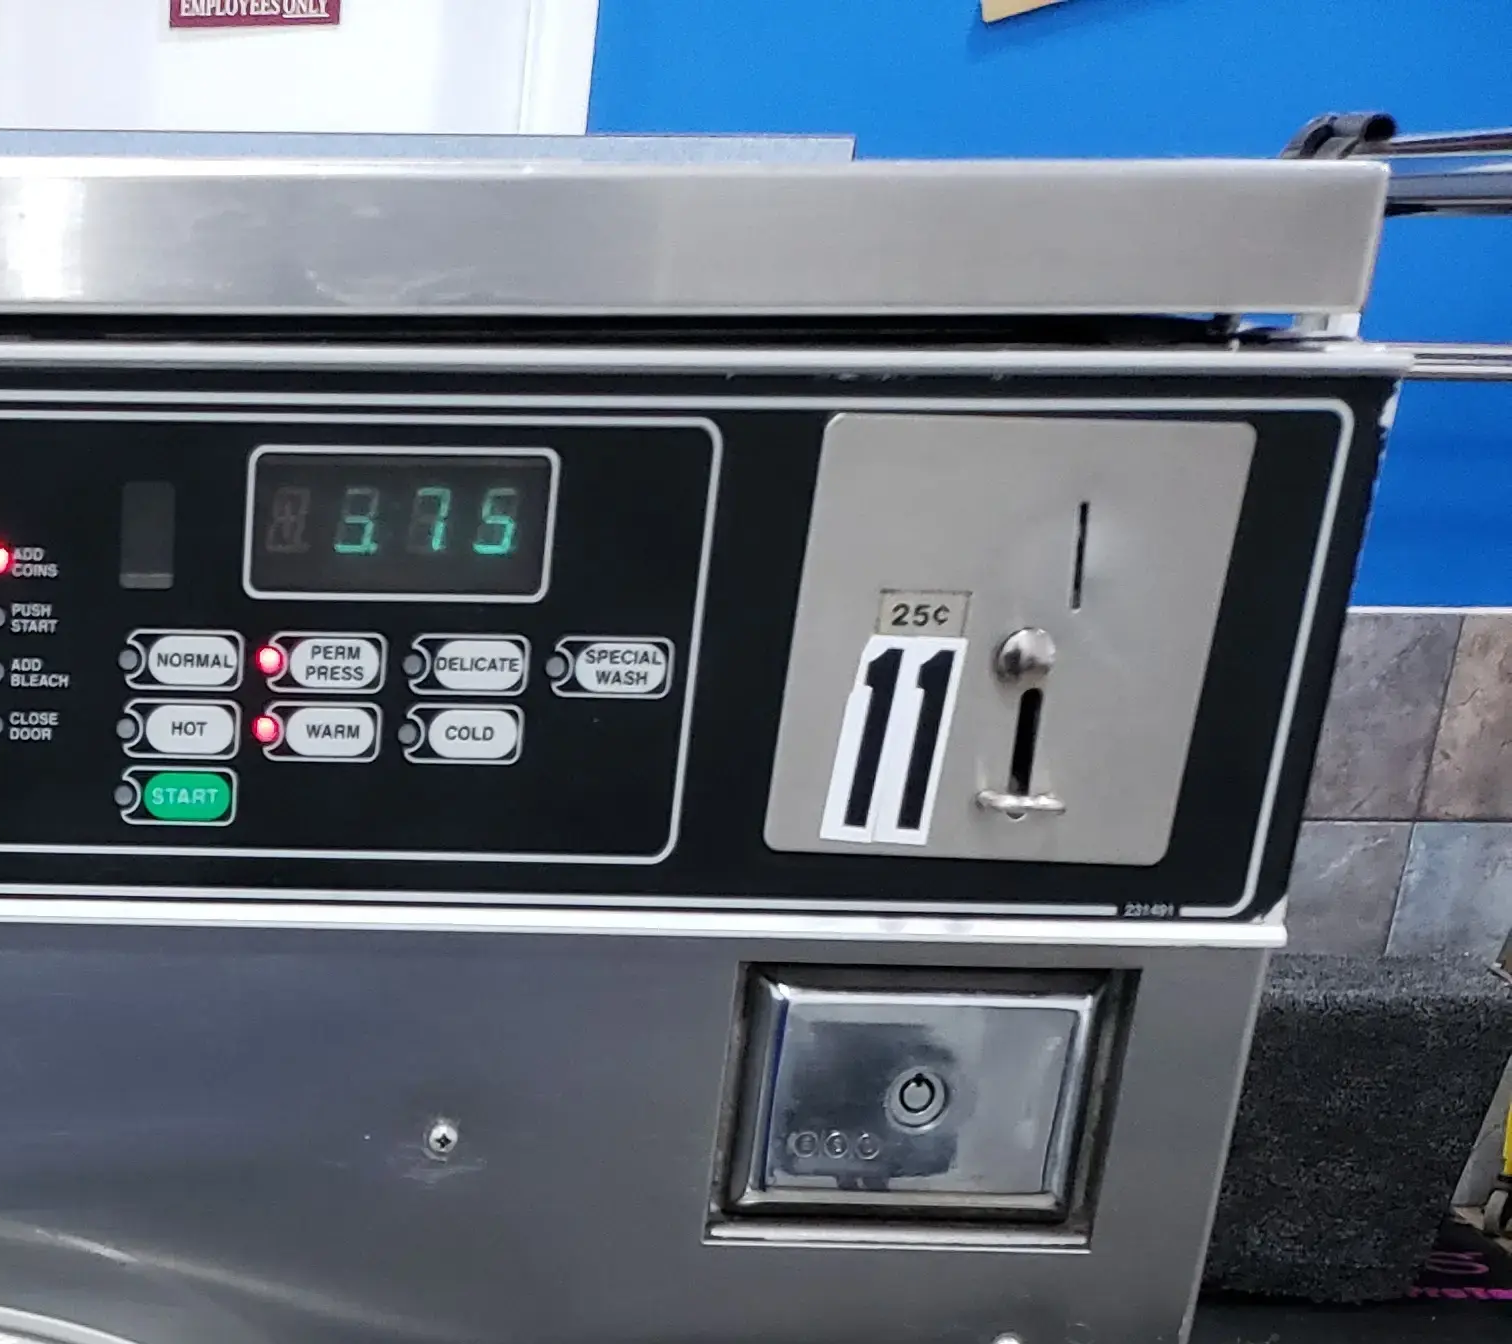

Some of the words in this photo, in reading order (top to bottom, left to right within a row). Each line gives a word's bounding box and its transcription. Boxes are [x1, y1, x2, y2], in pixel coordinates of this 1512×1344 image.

[13, 547, 45, 562] ADD
[12, 562, 59, 578] COINS
[11, 602, 52, 618] PUSH
[891, 603, 950, 627] 25¢
[10, 618, 58, 634] START
[156, 652, 234, 669] NORMAL
[310, 645, 362, 660] PERM
[585, 649, 663, 666] SPECIAL
[10, 658, 43, 673] ADD
[437, 655, 521, 673] DELICATE
[10, 673, 70, 688] BLEACH
[304, 665, 365, 682] PRESS
[595, 670, 649, 687] WASH
[9, 711, 60, 727] CLOSE
[9, 727, 53, 741] DOOR
[171, 721, 208, 737] HOT
[306, 724, 360, 740] WARM
[444, 725, 495, 742] COLD
[843, 648, 956, 829] 11
[151, 787, 219, 806] START
